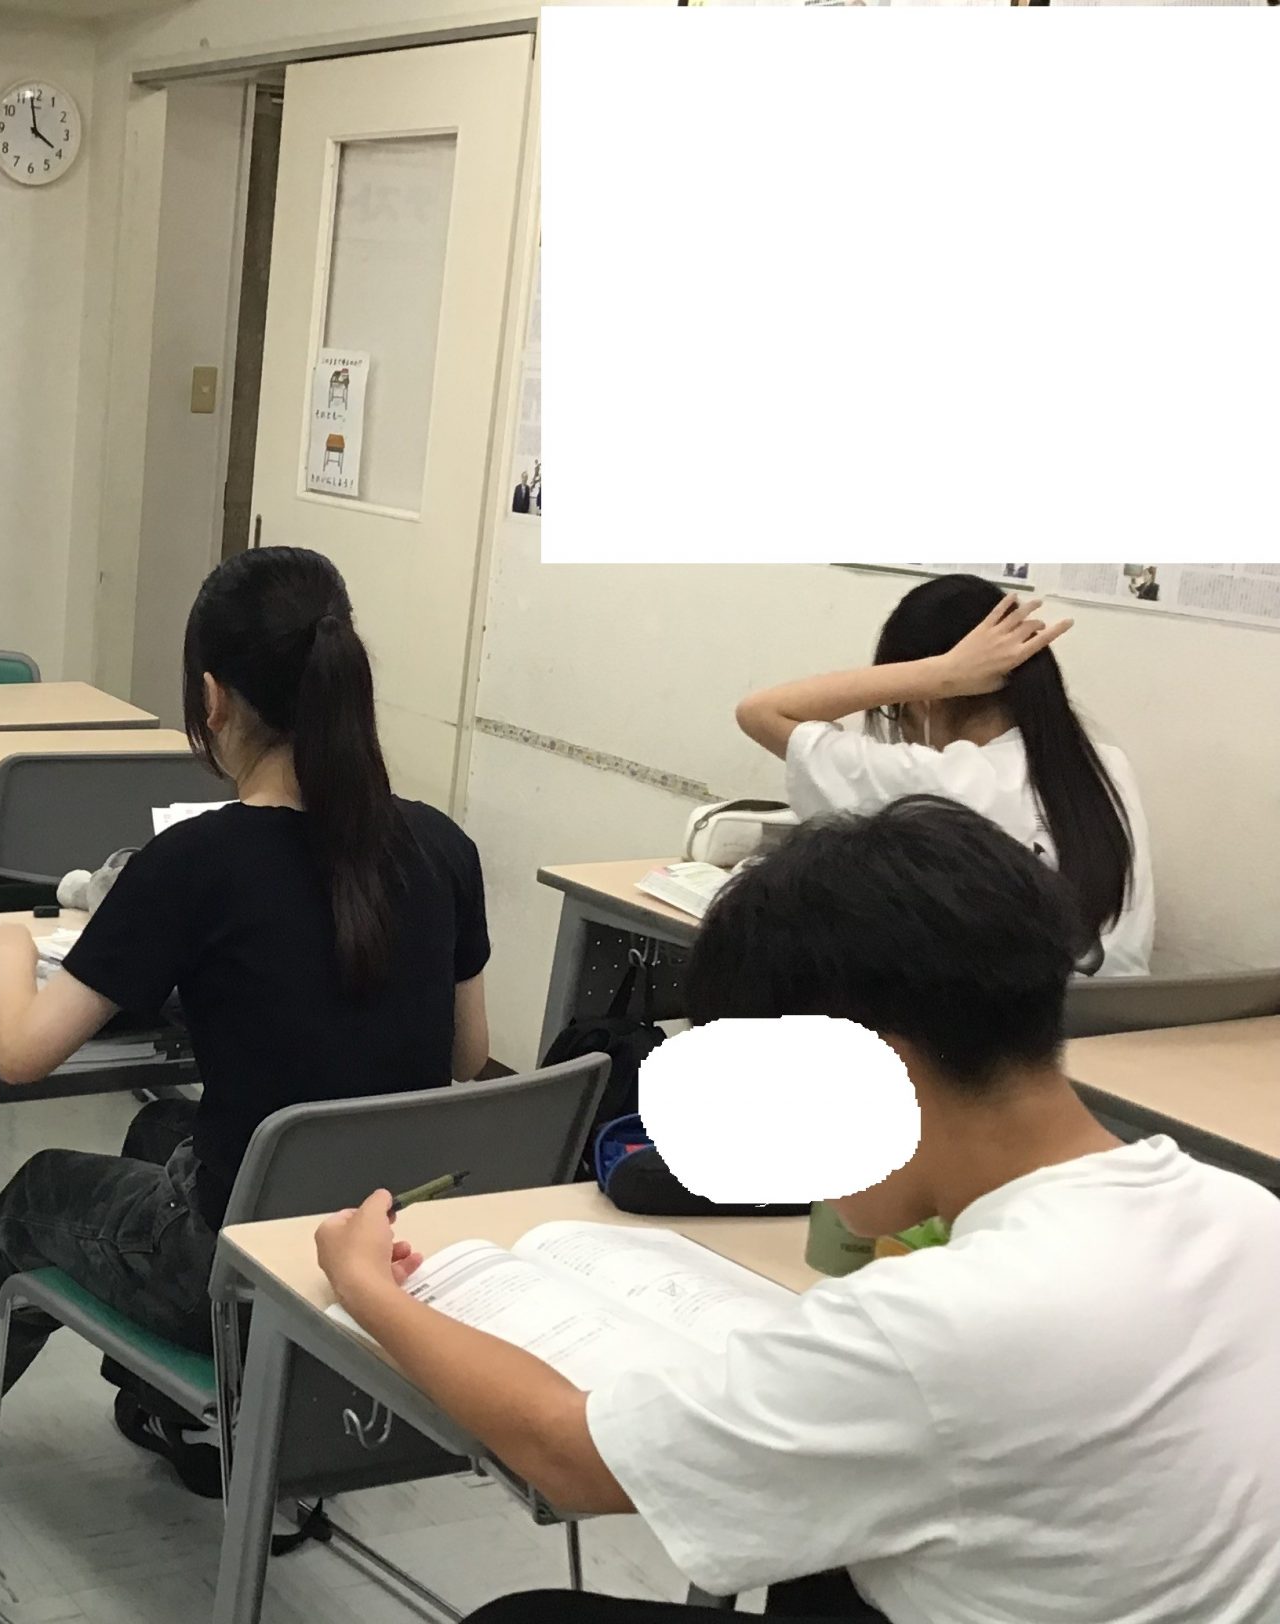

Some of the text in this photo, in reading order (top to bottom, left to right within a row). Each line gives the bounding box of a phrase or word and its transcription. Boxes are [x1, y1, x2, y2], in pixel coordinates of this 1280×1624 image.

[51, 96, 56, 108] 1
[4, 104, 16, 117] 10
[60, 111, 67, 123] 2
[63, 128, 70, 141] 3
[1, 141, 9, 154] 8
[55, 148, 63, 160] 4
[13, 155, 21, 168] 7
[27, 162, 35, 174] 6
[43, 158, 50, 171] 5
